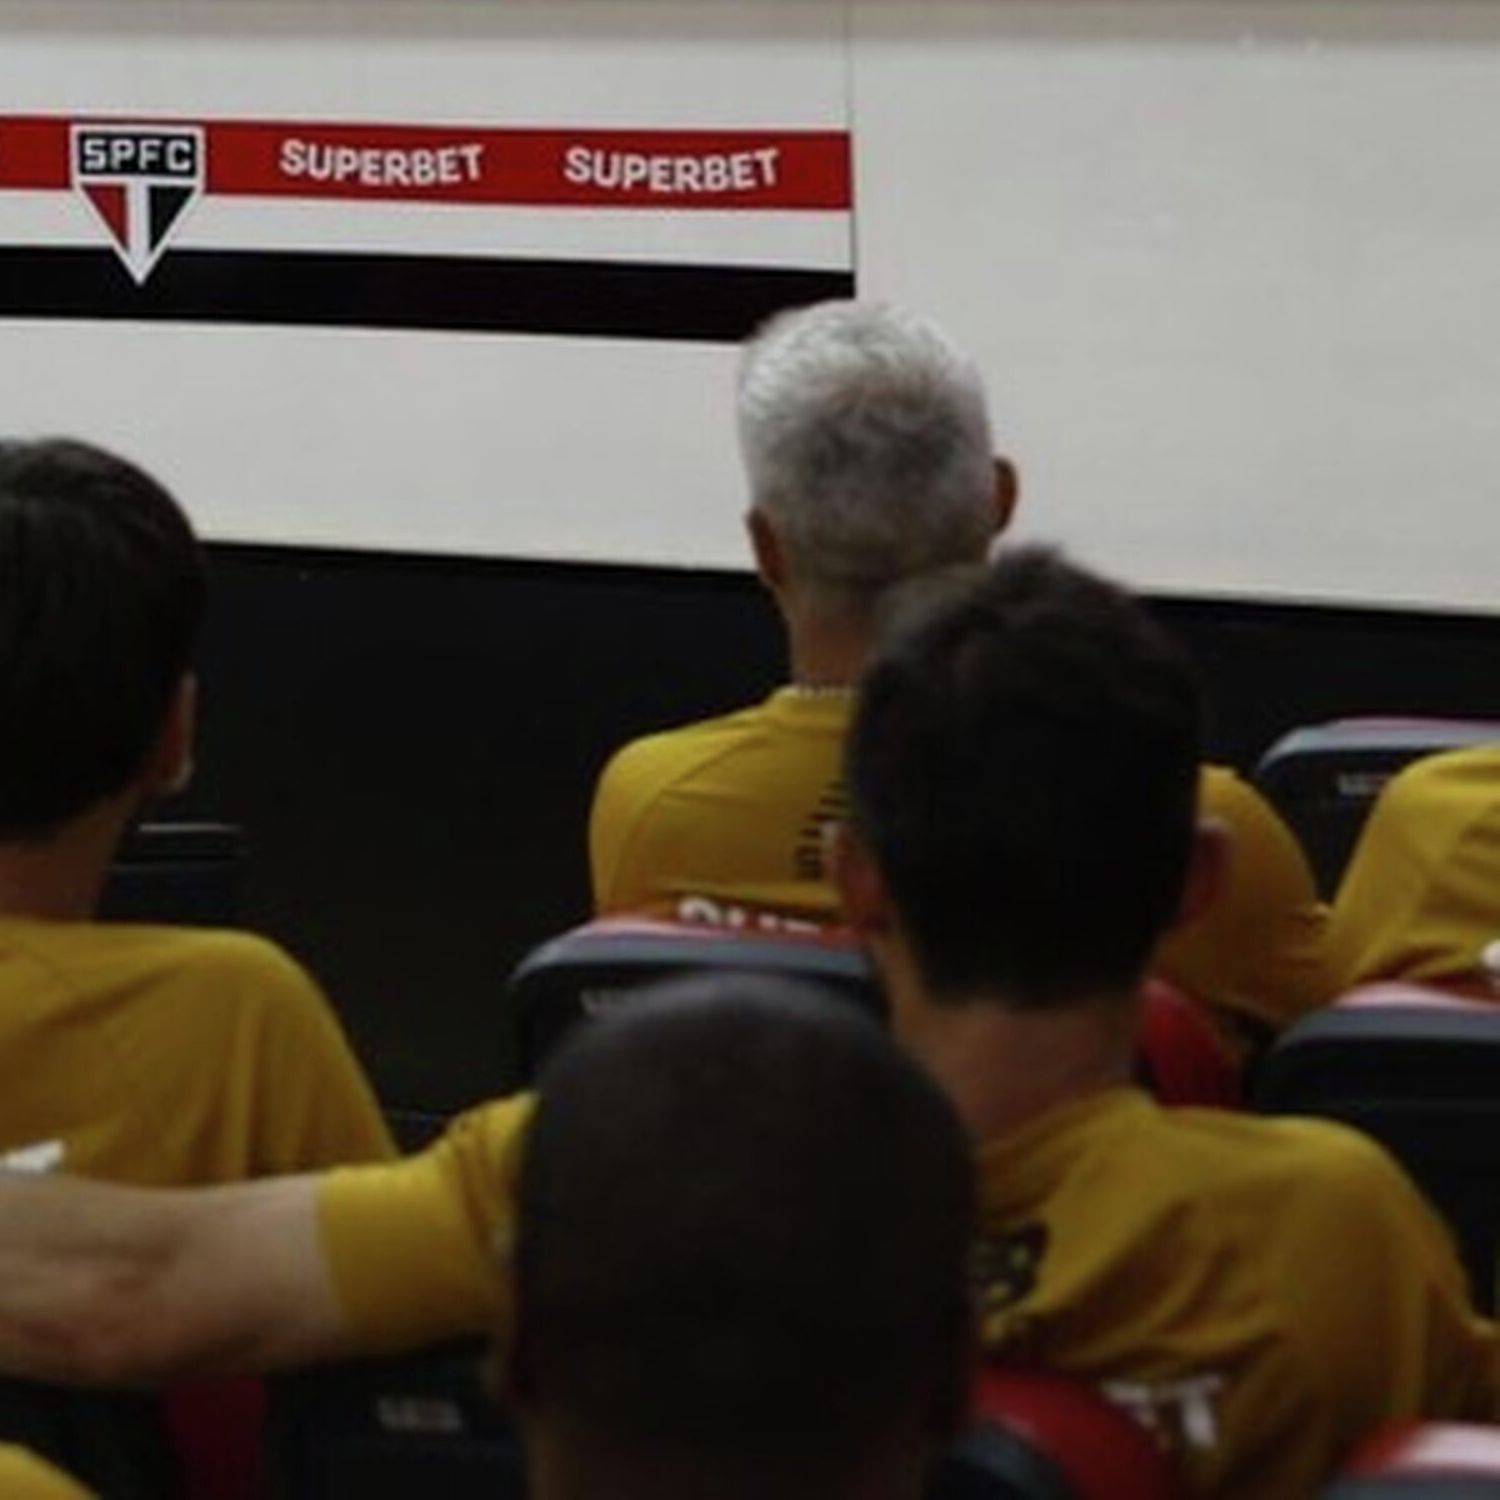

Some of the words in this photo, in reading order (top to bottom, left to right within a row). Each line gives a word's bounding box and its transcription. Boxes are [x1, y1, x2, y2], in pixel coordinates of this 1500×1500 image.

[81, 139, 194, 172] SPFC
[280, 139, 486, 188] SUPERBET
[564, 147, 779, 192] SUPERBET
